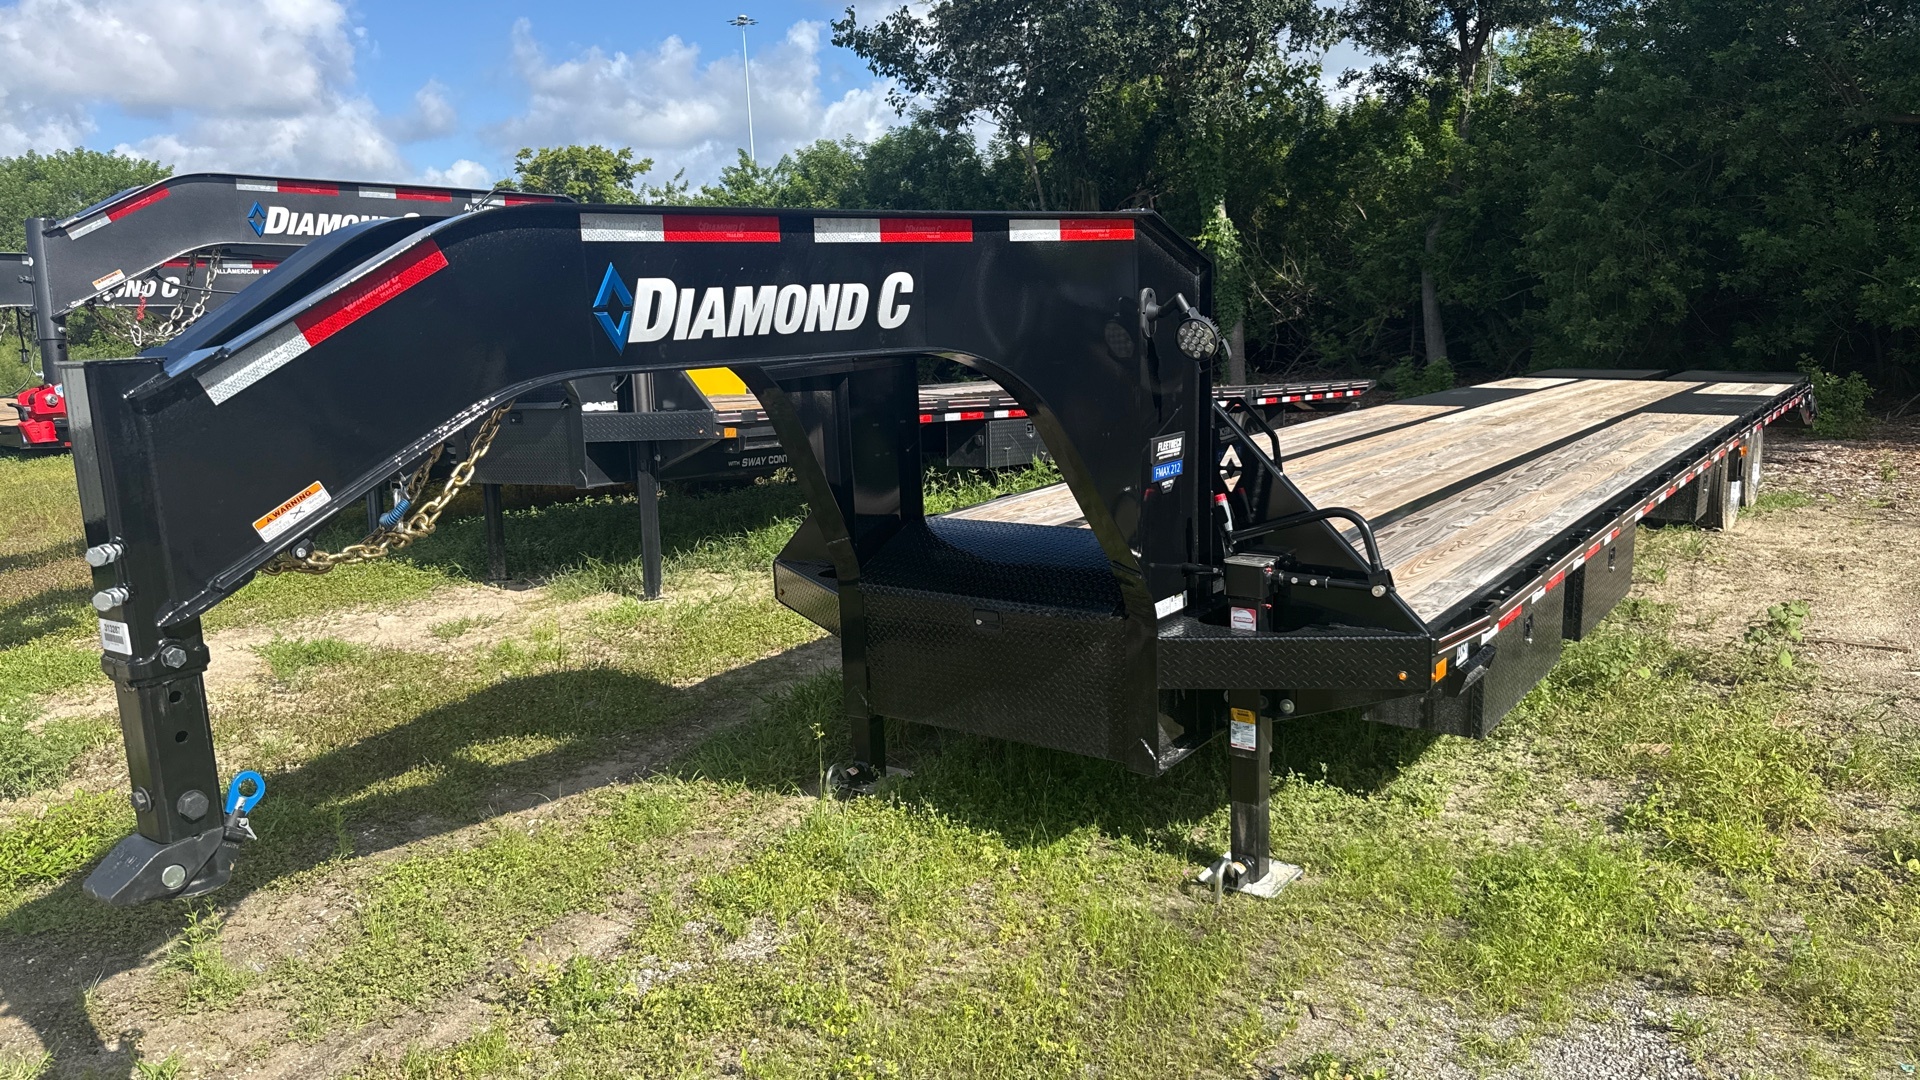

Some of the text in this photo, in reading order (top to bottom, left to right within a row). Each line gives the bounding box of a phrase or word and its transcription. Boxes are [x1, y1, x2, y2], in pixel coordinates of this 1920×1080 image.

[628, 271, 914, 343] DIAMOND C
[741, 456, 767, 467] SWAY
[1155, 462, 1181, 479] FMAX 212
[272, 490, 312, 518] WARNING
